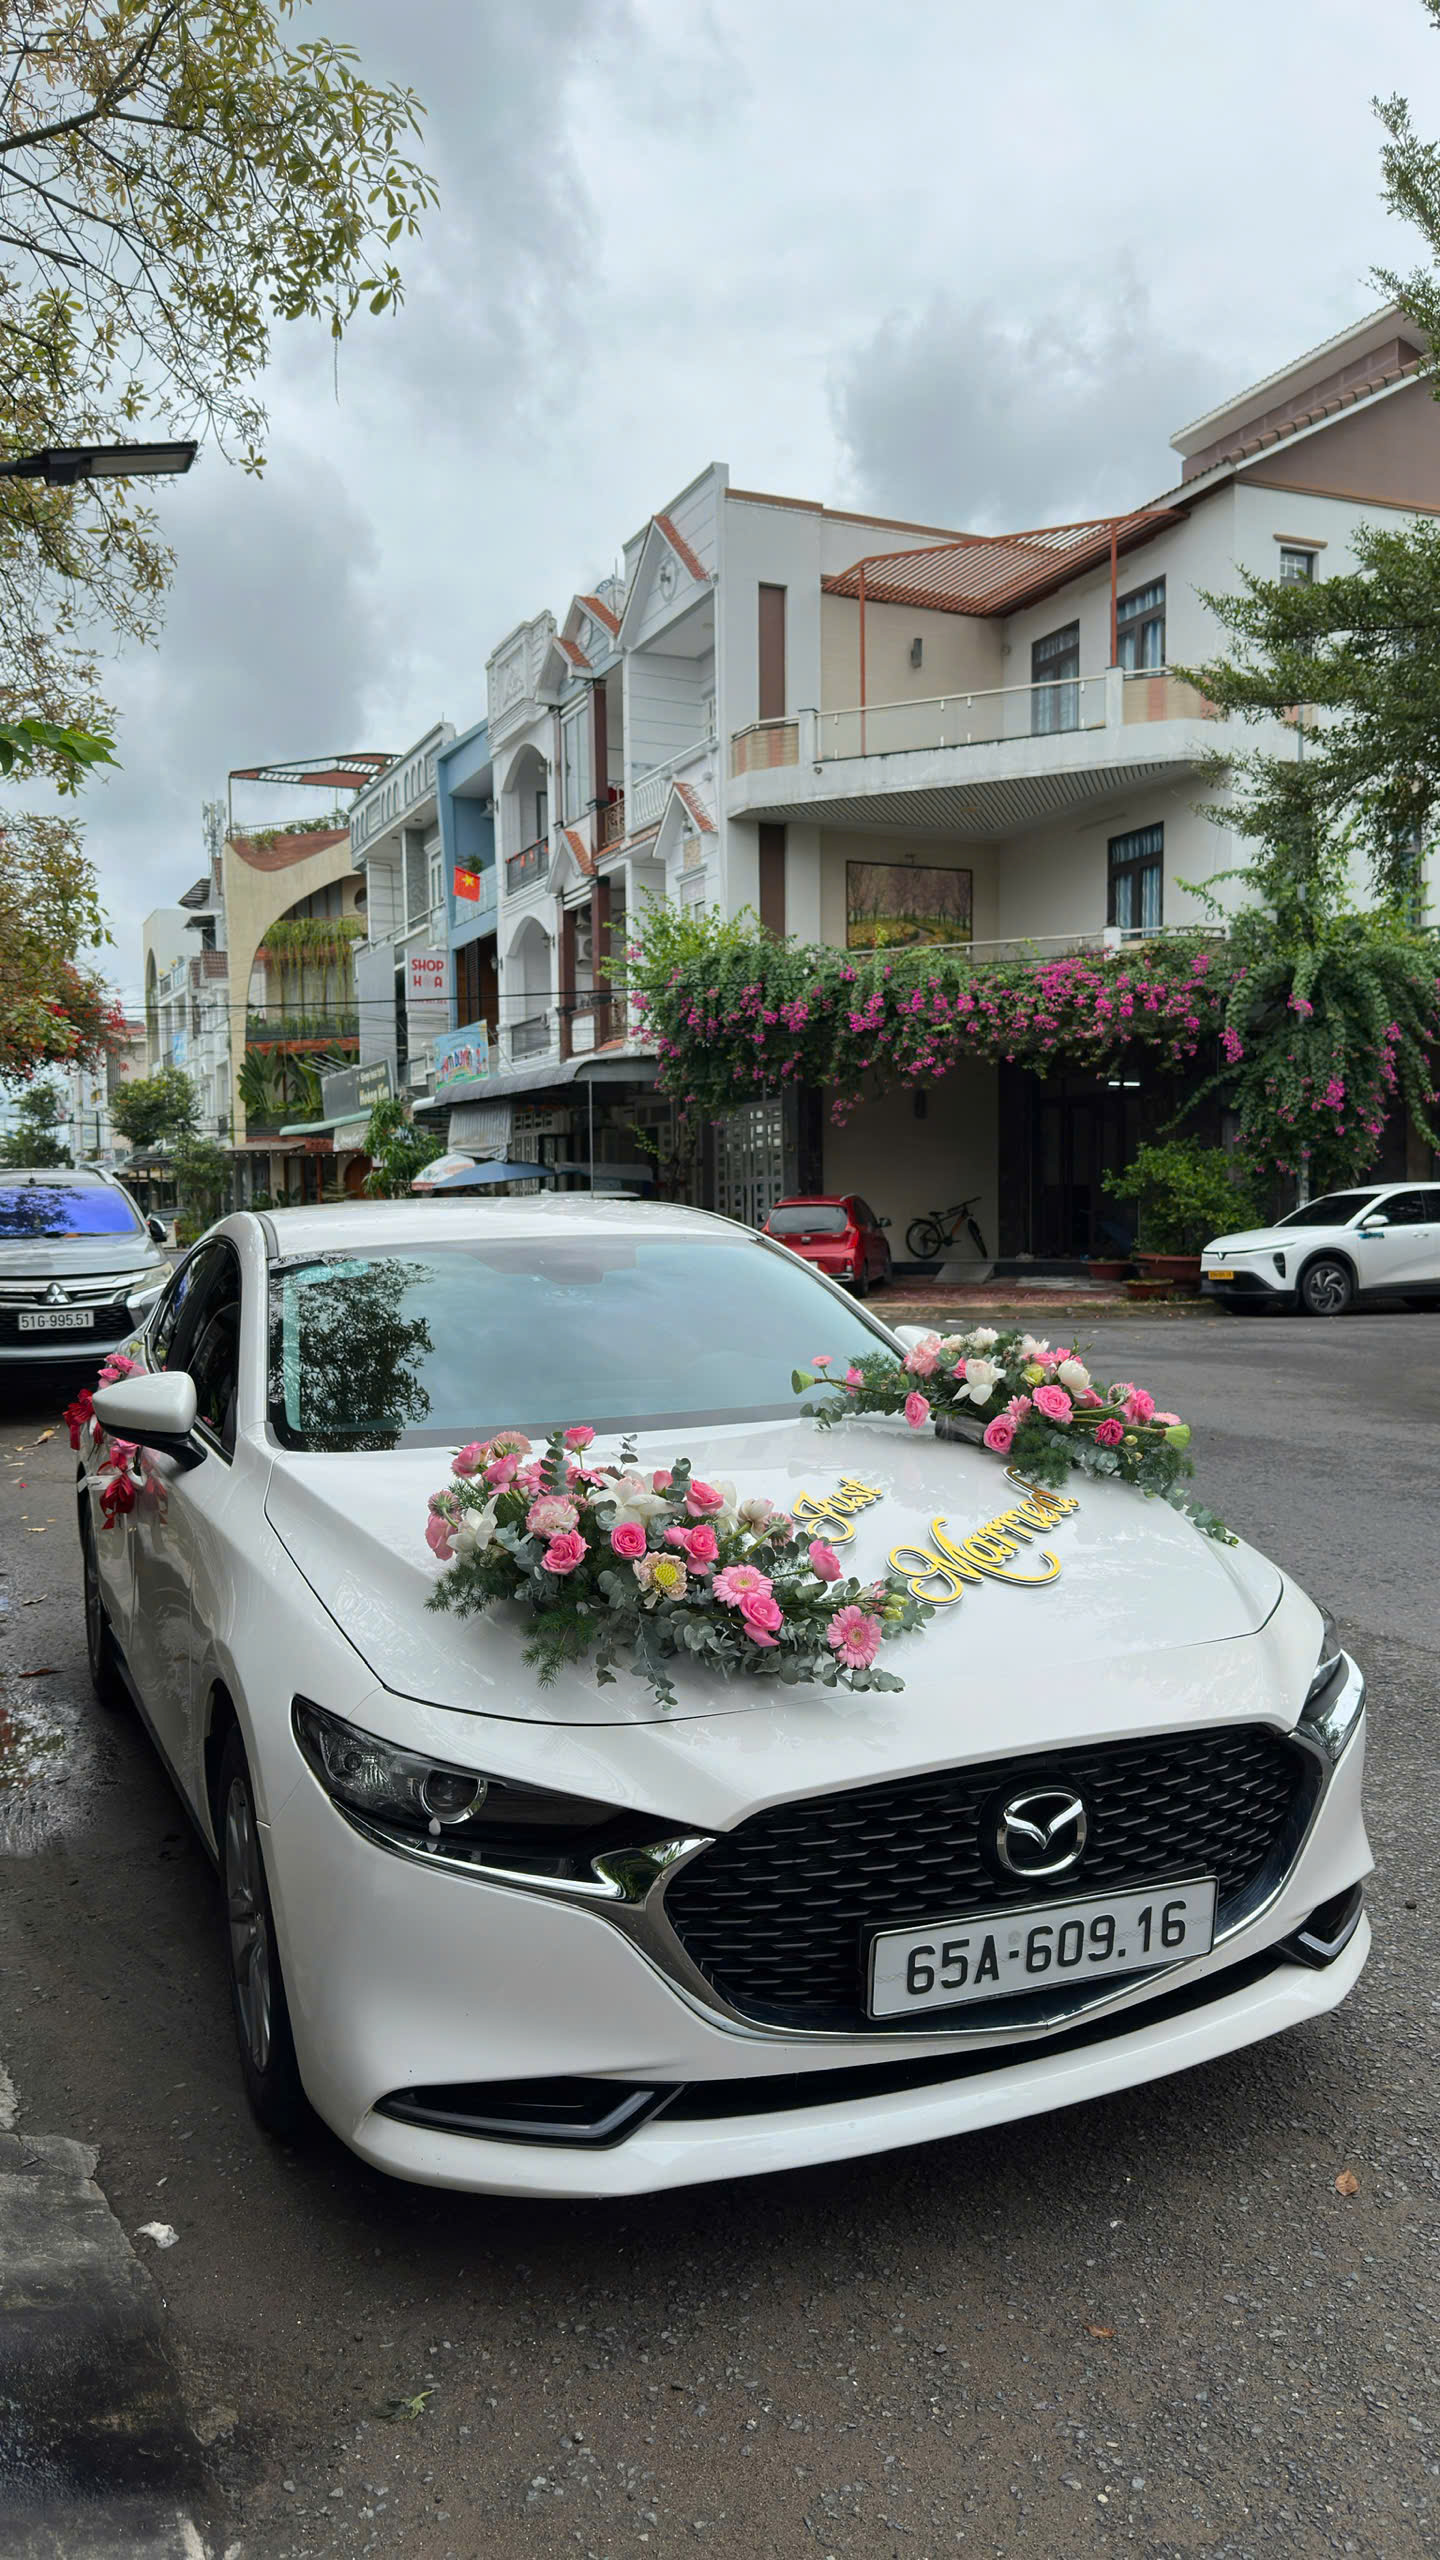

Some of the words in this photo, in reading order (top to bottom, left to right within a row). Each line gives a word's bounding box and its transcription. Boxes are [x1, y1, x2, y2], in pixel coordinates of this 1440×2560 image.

[411, 959, 445, 972] SHOP
[413, 975, 443, 988] HA
[21, 1313, 90, 1329] 51G-995.51
[790, 1477, 883, 1546] Just
[886, 1466, 1081, 1606] Married
[906, 1900, 1188, 1995] 65A-609.16
